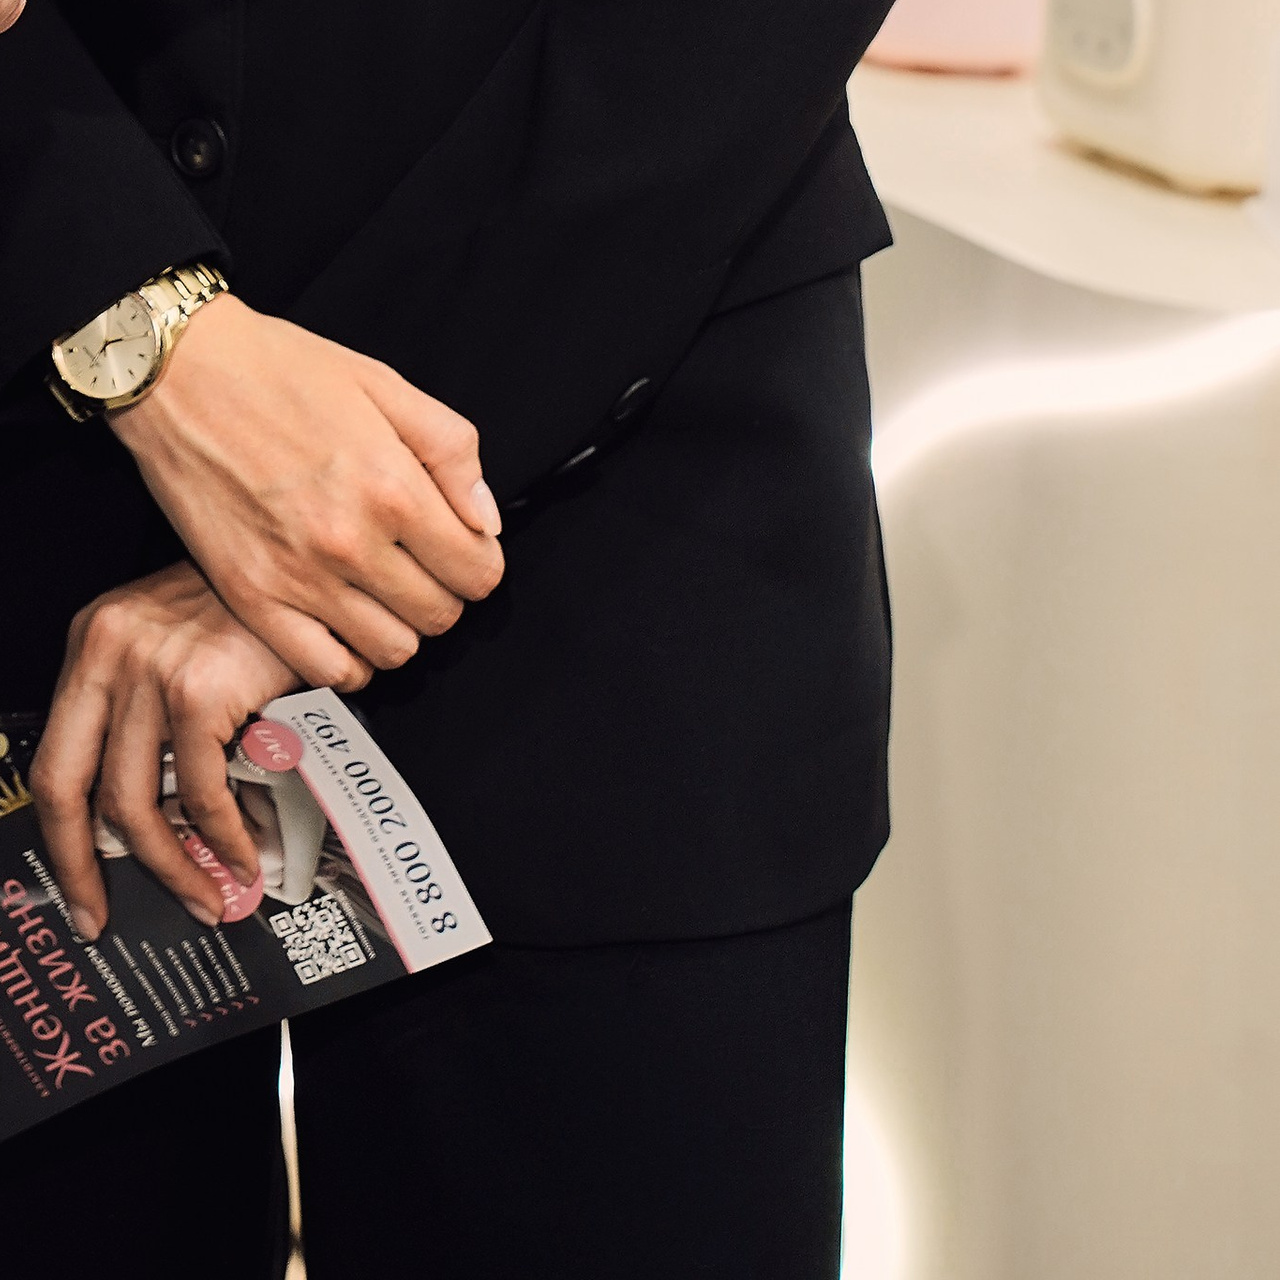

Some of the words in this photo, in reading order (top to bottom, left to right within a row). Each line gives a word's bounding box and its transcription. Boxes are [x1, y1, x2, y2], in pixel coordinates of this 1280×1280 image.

[300, 703, 355, 758] 492
[340, 755, 409, 836] 2000
[389, 835, 446, 908] 800
[428, 908, 459, 934] 8
[80, 944, 140, 1018] помогаем
[80, 1013, 133, 1068] за
[129, 1014, 159, 1049] Мы
